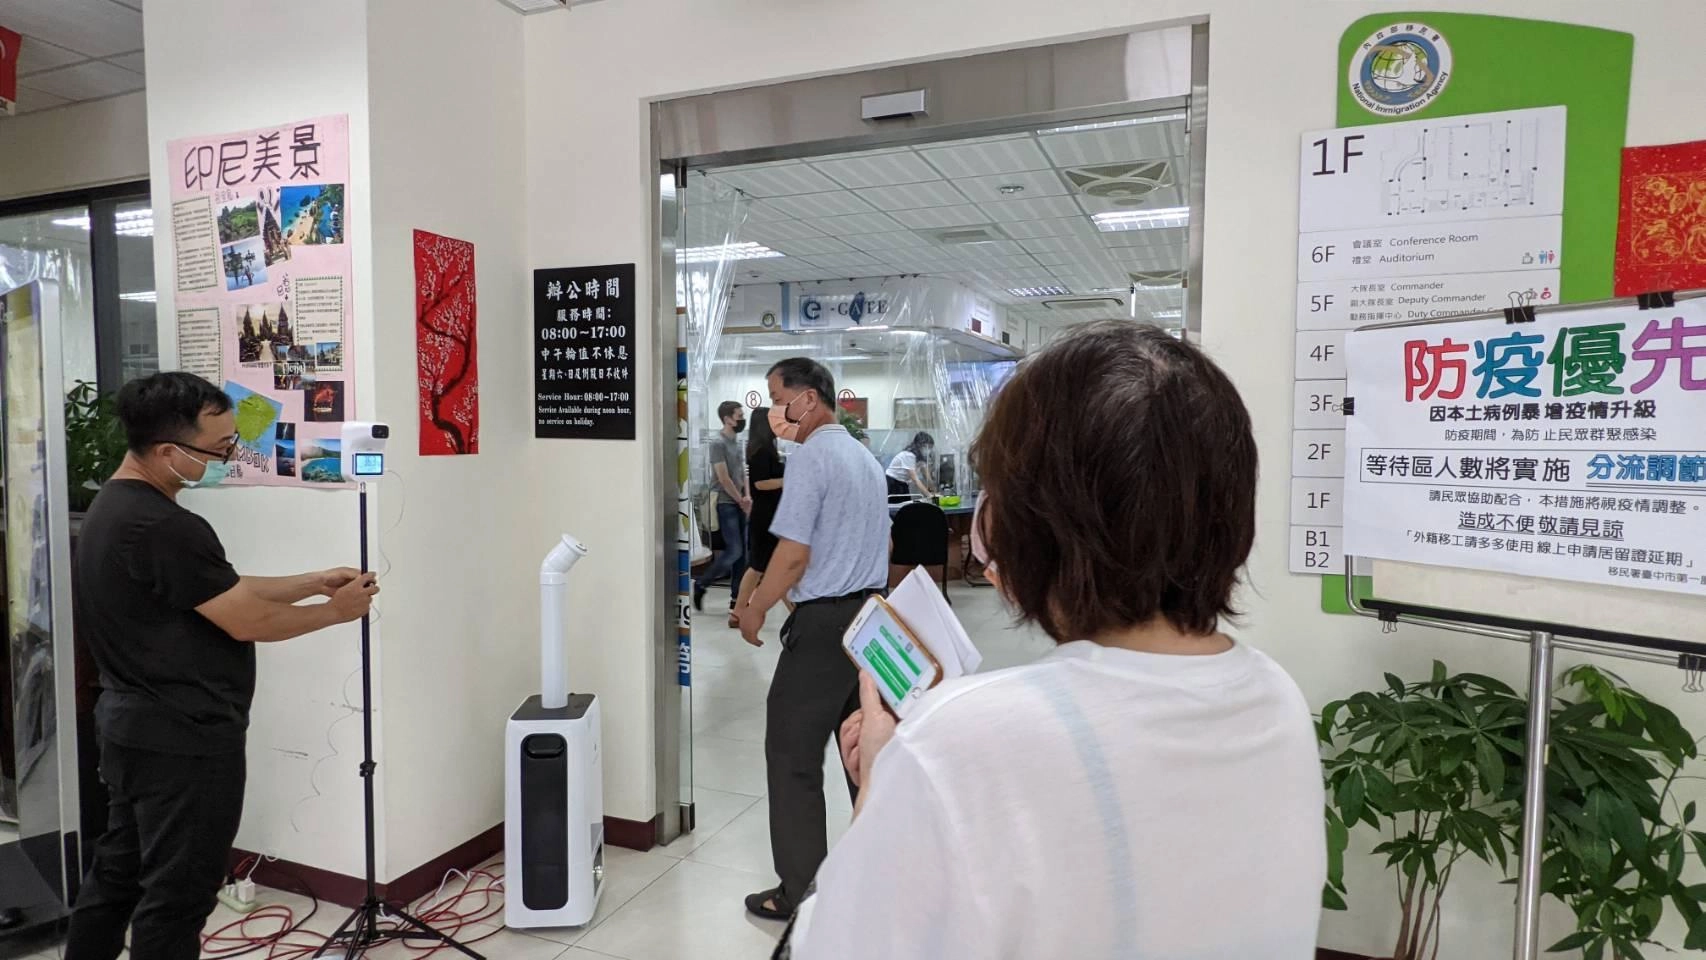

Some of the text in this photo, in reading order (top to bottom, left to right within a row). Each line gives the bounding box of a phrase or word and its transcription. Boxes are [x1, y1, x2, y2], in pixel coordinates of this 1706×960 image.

[1352, 71, 1449, 114] National Immigration Agency
[184, 124, 321, 191] 印尼美景
[1312, 134, 1365, 176] 1F
[1352, 233, 1479, 249] 會議室 Conference Room
[1311, 246, 1336, 263] 6F
[1352, 252, 1435, 265] 禮堂 Auditorium
[546, 277, 620, 301] 辦公時間
[1391, 281, 1444, 291] Commander
[1310, 295, 1334, 312] 5F
[1398, 296, 1429, 305] Deputy
[1431, 293, 1486, 303] Commander
[1407, 309, 1429, 319] Duty
[541, 345, 629, 361] 中午輪值不休息
[1310, 345, 1334, 361] 4F
[1404, 317, 1706, 402] 防疫優先
[538, 393, 562, 401] Service
[564, 393, 583, 401] Hour:
[1309, 395, 1333, 411] 3F
[538, 405, 557, 414] Service
[559, 405, 582, 414] Available
[583, 405, 601, 415] during
[1430, 400, 1656, 422] 因本土病例暴增疫情升級
[1307, 444, 1331, 460] 2F
[1366, 454, 1706, 483] 等待區人數將實施 分流調節
[1307, 492, 1330, 508] 1F
[1459, 511, 1625, 539] 造成不便敬請見諒
[1306, 531, 1330, 547] B1
[1305, 552, 1329, 567] B2
